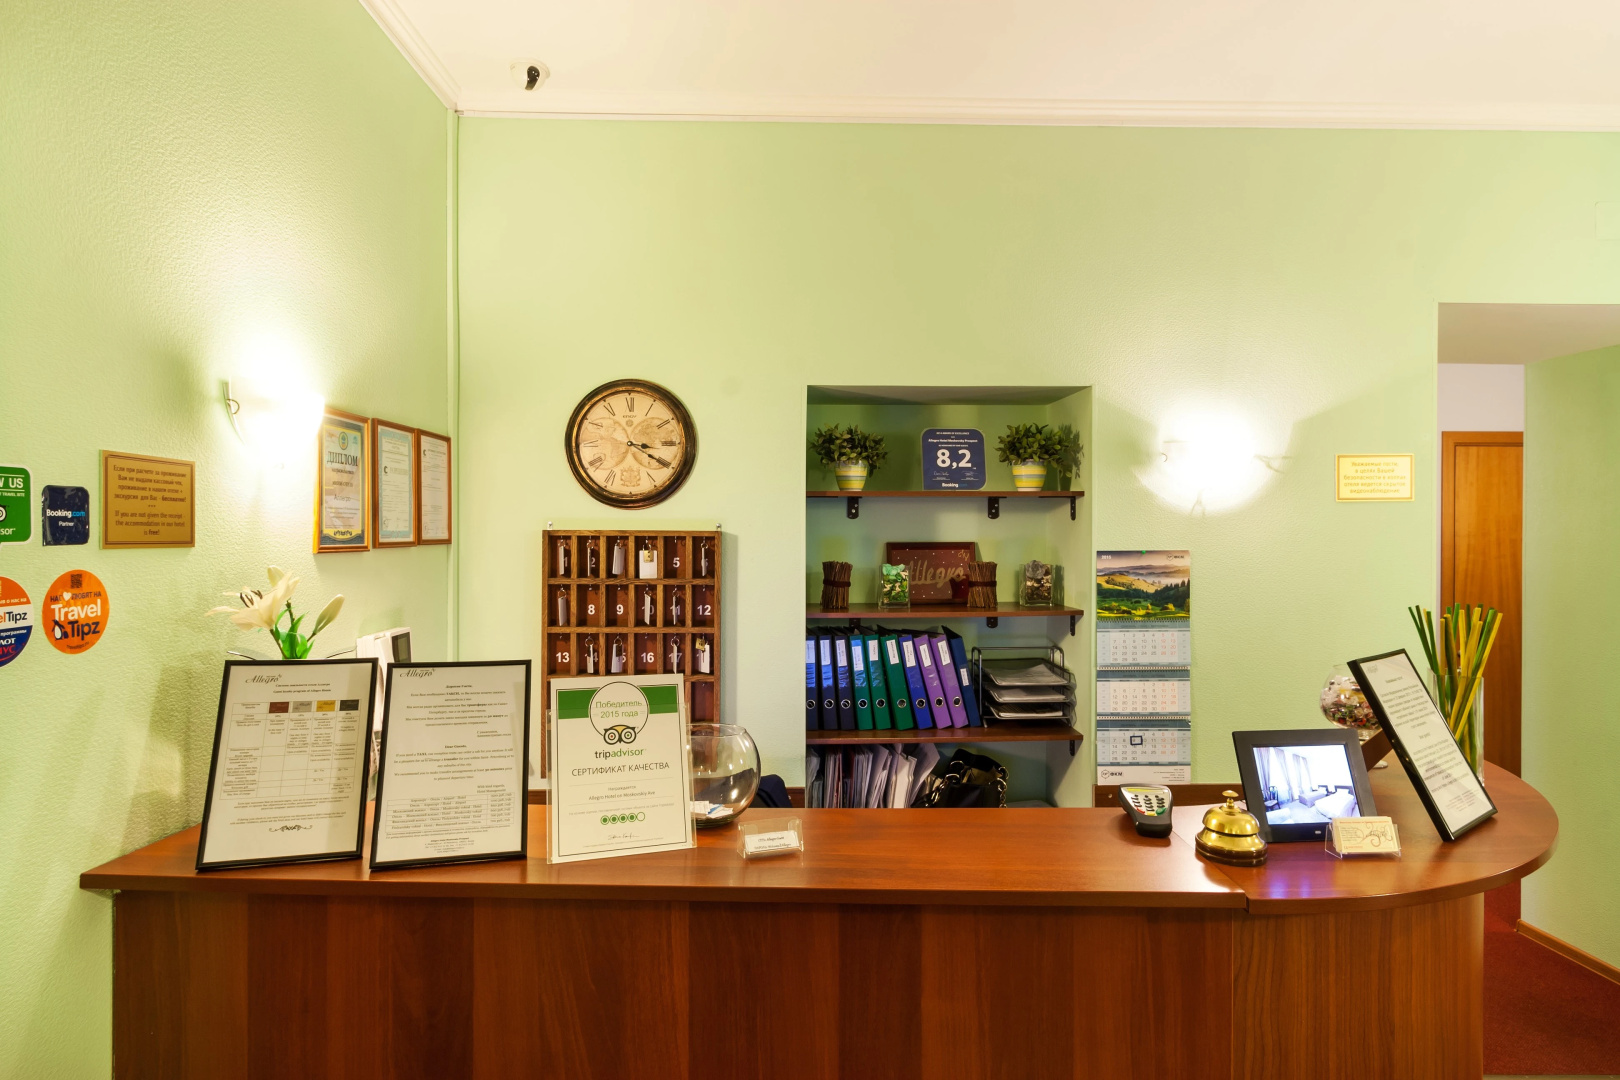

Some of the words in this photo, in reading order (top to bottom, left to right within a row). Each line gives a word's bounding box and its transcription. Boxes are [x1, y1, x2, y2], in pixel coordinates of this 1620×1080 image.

[327, 451, 358, 467] ДИПЛОМ
[936, 448, 972, 470] 8,2
[9, 477, 24, 489] US
[46, 509, 86, 518] Booking.com
[672, 557, 681, 568] 5
[50, 594, 63, 603] НАС
[93, 590, 102, 598] НА
[50, 598, 101, 621] Travel
[587, 604, 596, 615] 8
[616, 604, 624, 615] 9
[697, 605, 712, 615] 12
[67, 620, 101, 641] Tipz
[555, 652, 570, 663] 13
[641, 652, 655, 663] 16
[399, 668, 433, 678] Allegro
[245, 674, 279, 684] Allegro
[595, 700, 643, 710] Победитель
[600, 710, 620, 719] 2015
[621, 710, 639, 719] года
[594, 748, 645, 760] tripadvisor
[571, 764, 627, 777] СЕРТИФИКАТ
[628, 761, 670, 772] КАЧЕСТВА
[588, 793, 603, 801] Allegro
